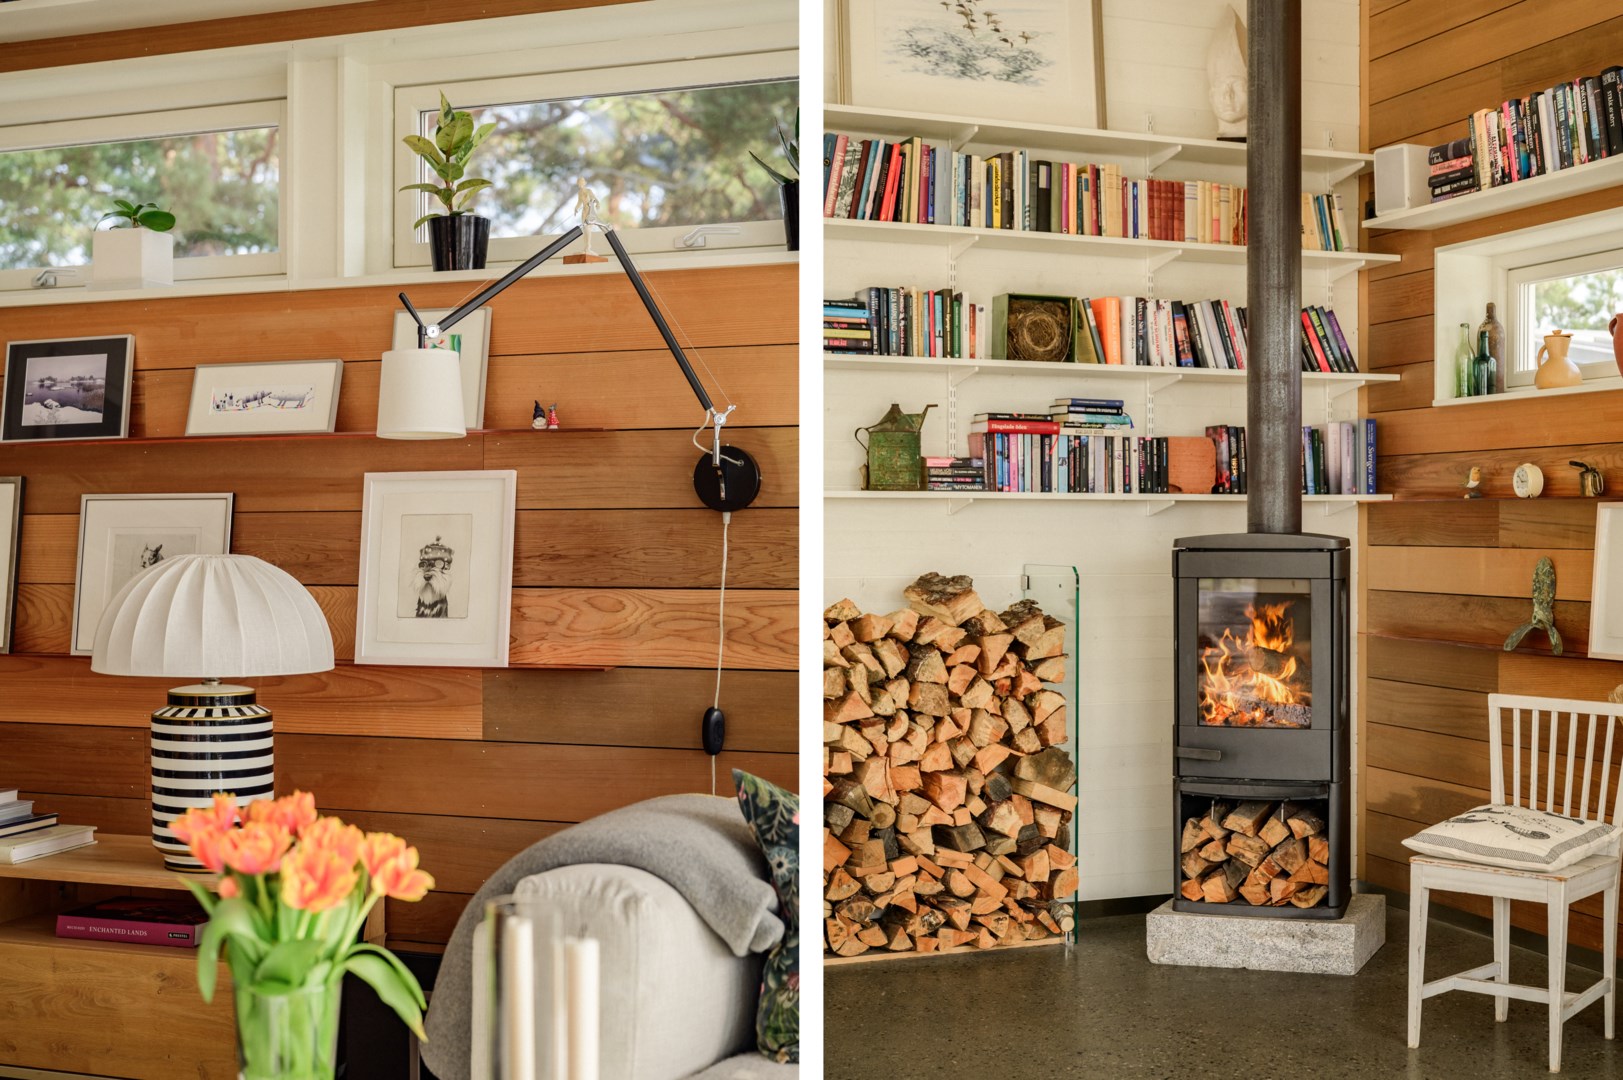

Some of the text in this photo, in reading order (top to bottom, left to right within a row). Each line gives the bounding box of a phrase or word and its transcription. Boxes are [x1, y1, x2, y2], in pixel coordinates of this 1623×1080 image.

[890, 291, 898, 302] LIZA
[890, 303, 898, 332] MARKLUND
[1137, 321, 1145, 336] Sten
[1366, 445, 1374, 473] Sveriges
[89, 926, 126, 935] ENCHANTED
[127, 929, 149, 937] LANDS
